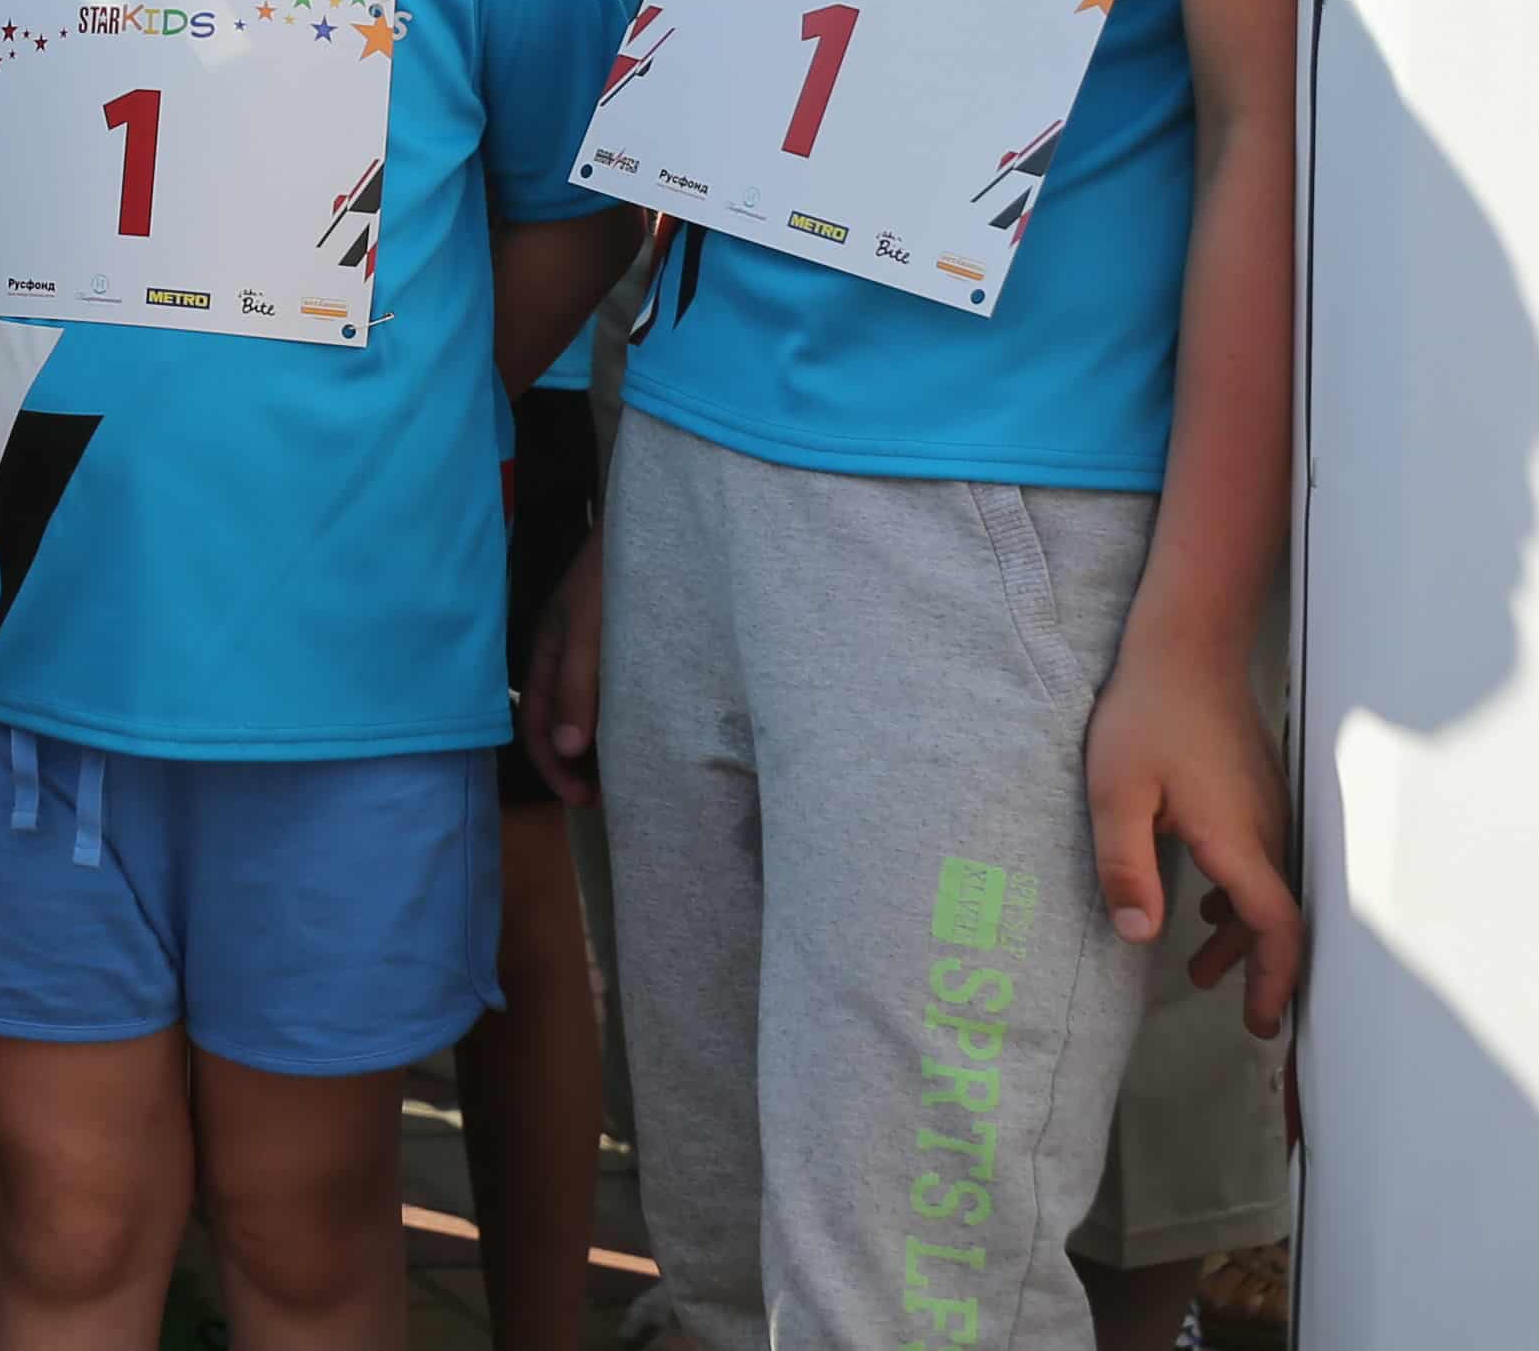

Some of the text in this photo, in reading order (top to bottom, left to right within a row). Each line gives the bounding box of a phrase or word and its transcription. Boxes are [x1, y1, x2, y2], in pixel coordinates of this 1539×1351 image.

[78, 4, 216, 38] STARKIDS
[782, 4, 860, 159] 1
[103, 89, 162, 237] 1
[658, 169, 709, 194] Русфонд
[790, 214, 846, 241] METRO
[875, 239, 910, 265] Bite
[8, 278, 56, 291] Русфонд
[148, 290, 208, 308] METRO
[241, 297, 276, 317] Bite
